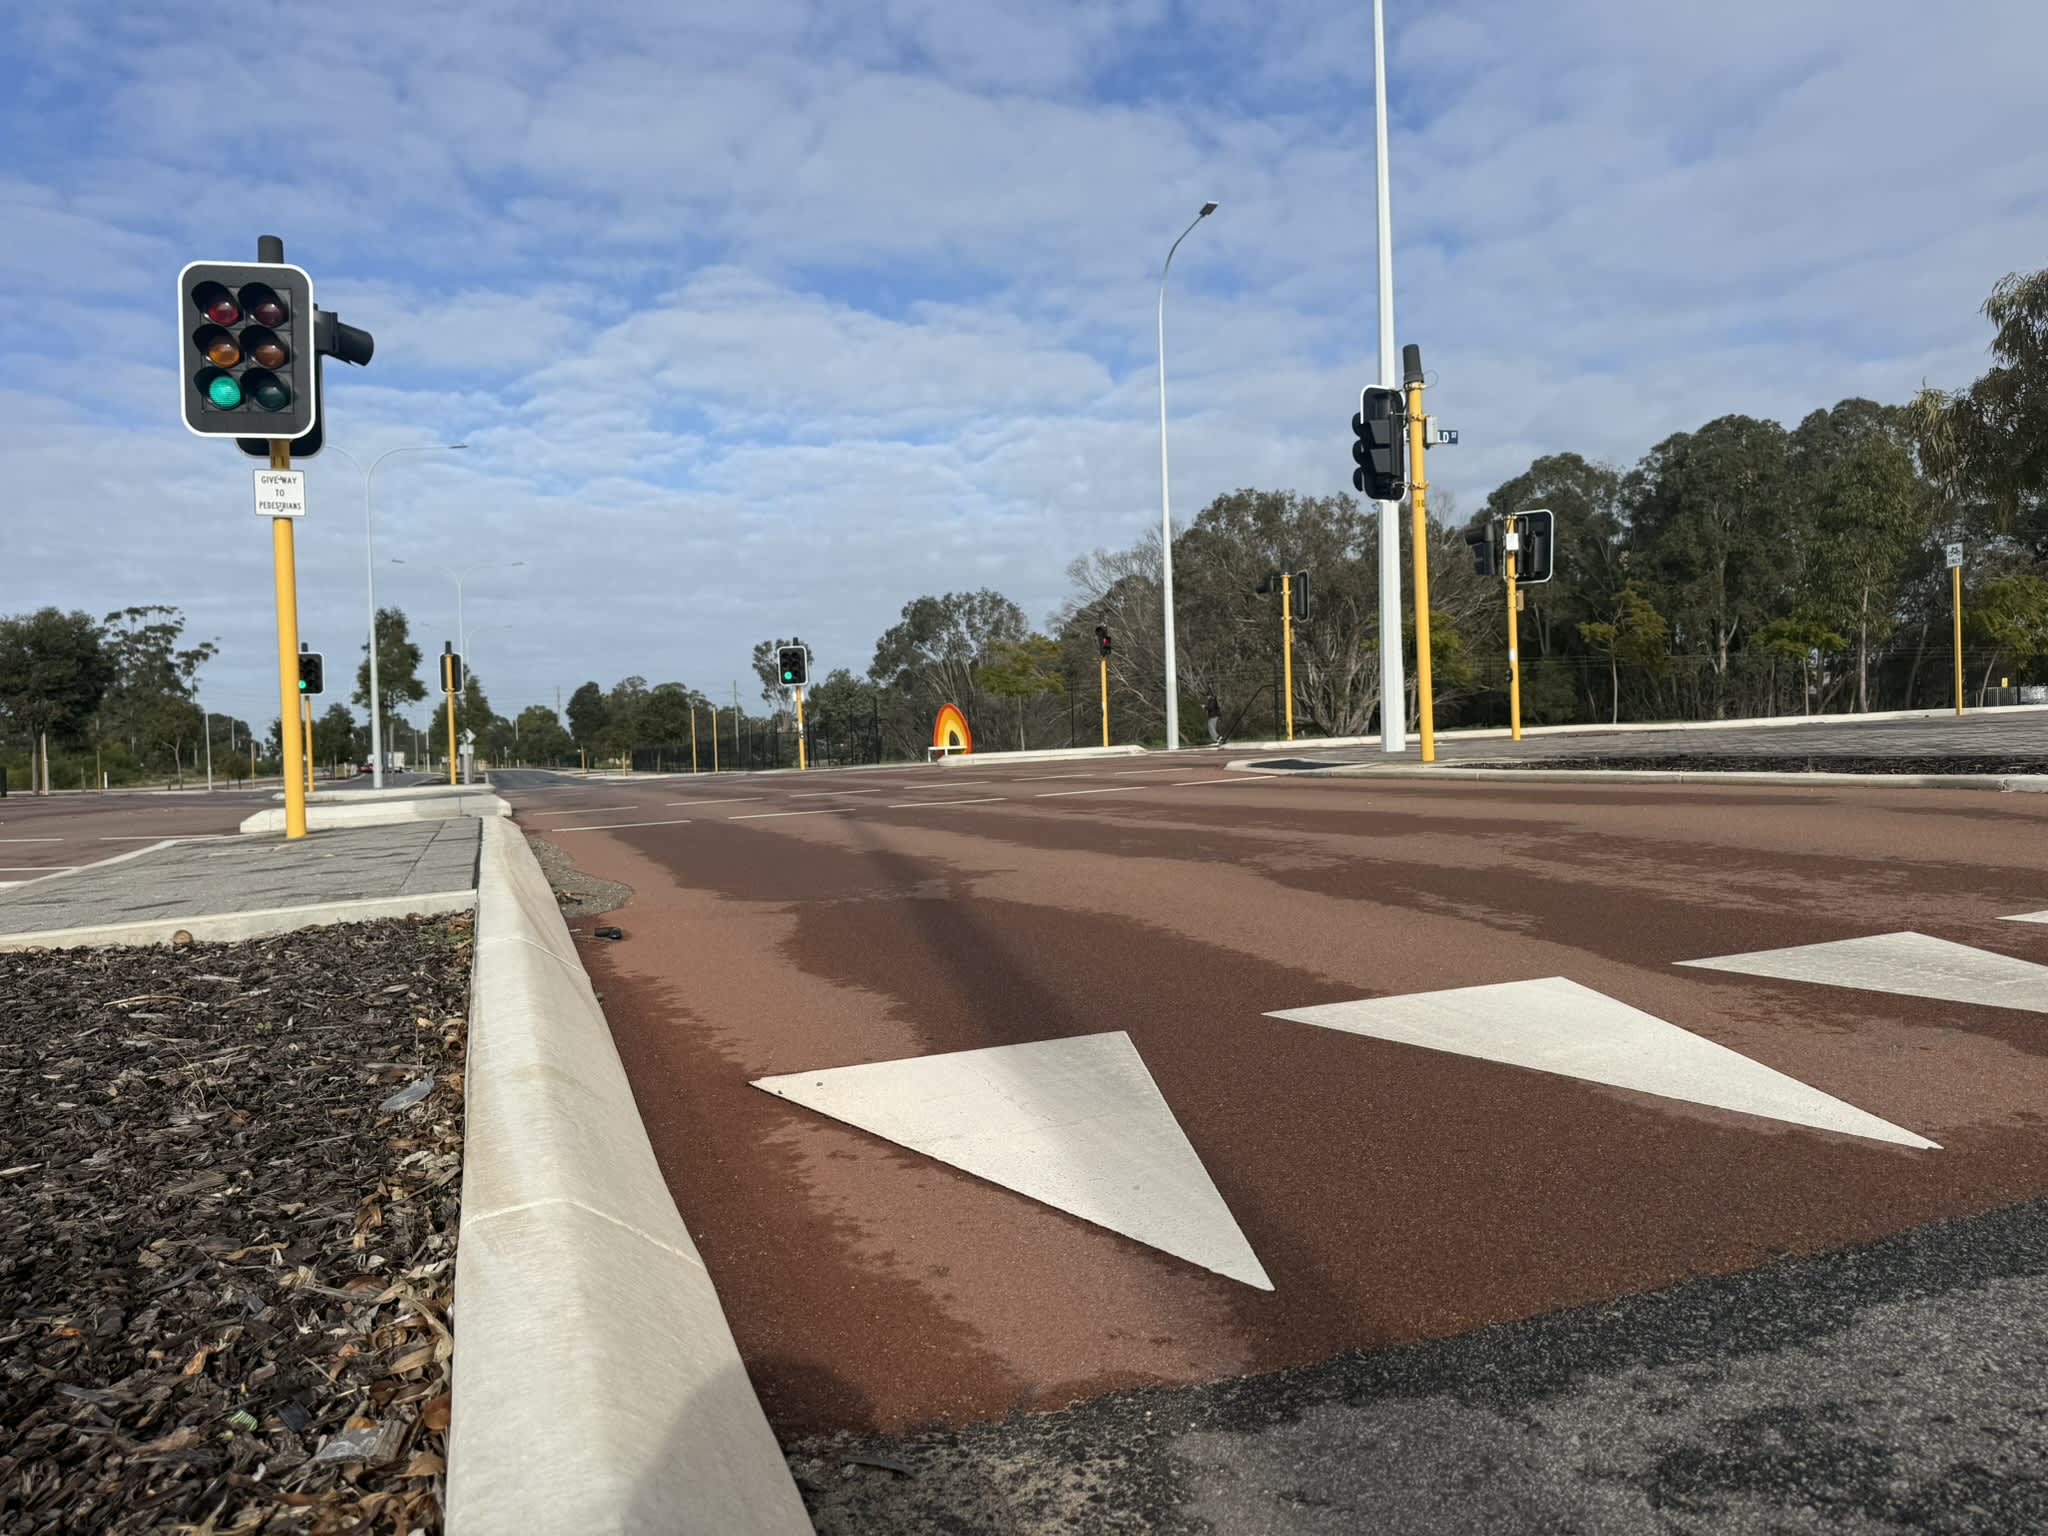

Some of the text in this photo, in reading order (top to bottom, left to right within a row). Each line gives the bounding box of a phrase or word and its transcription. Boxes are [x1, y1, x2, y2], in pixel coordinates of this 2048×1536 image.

[261, 475, 296, 484] GIVE WAY
[275, 488, 285, 497] TO
[259, 501, 301, 510] PEDESTRIANS
